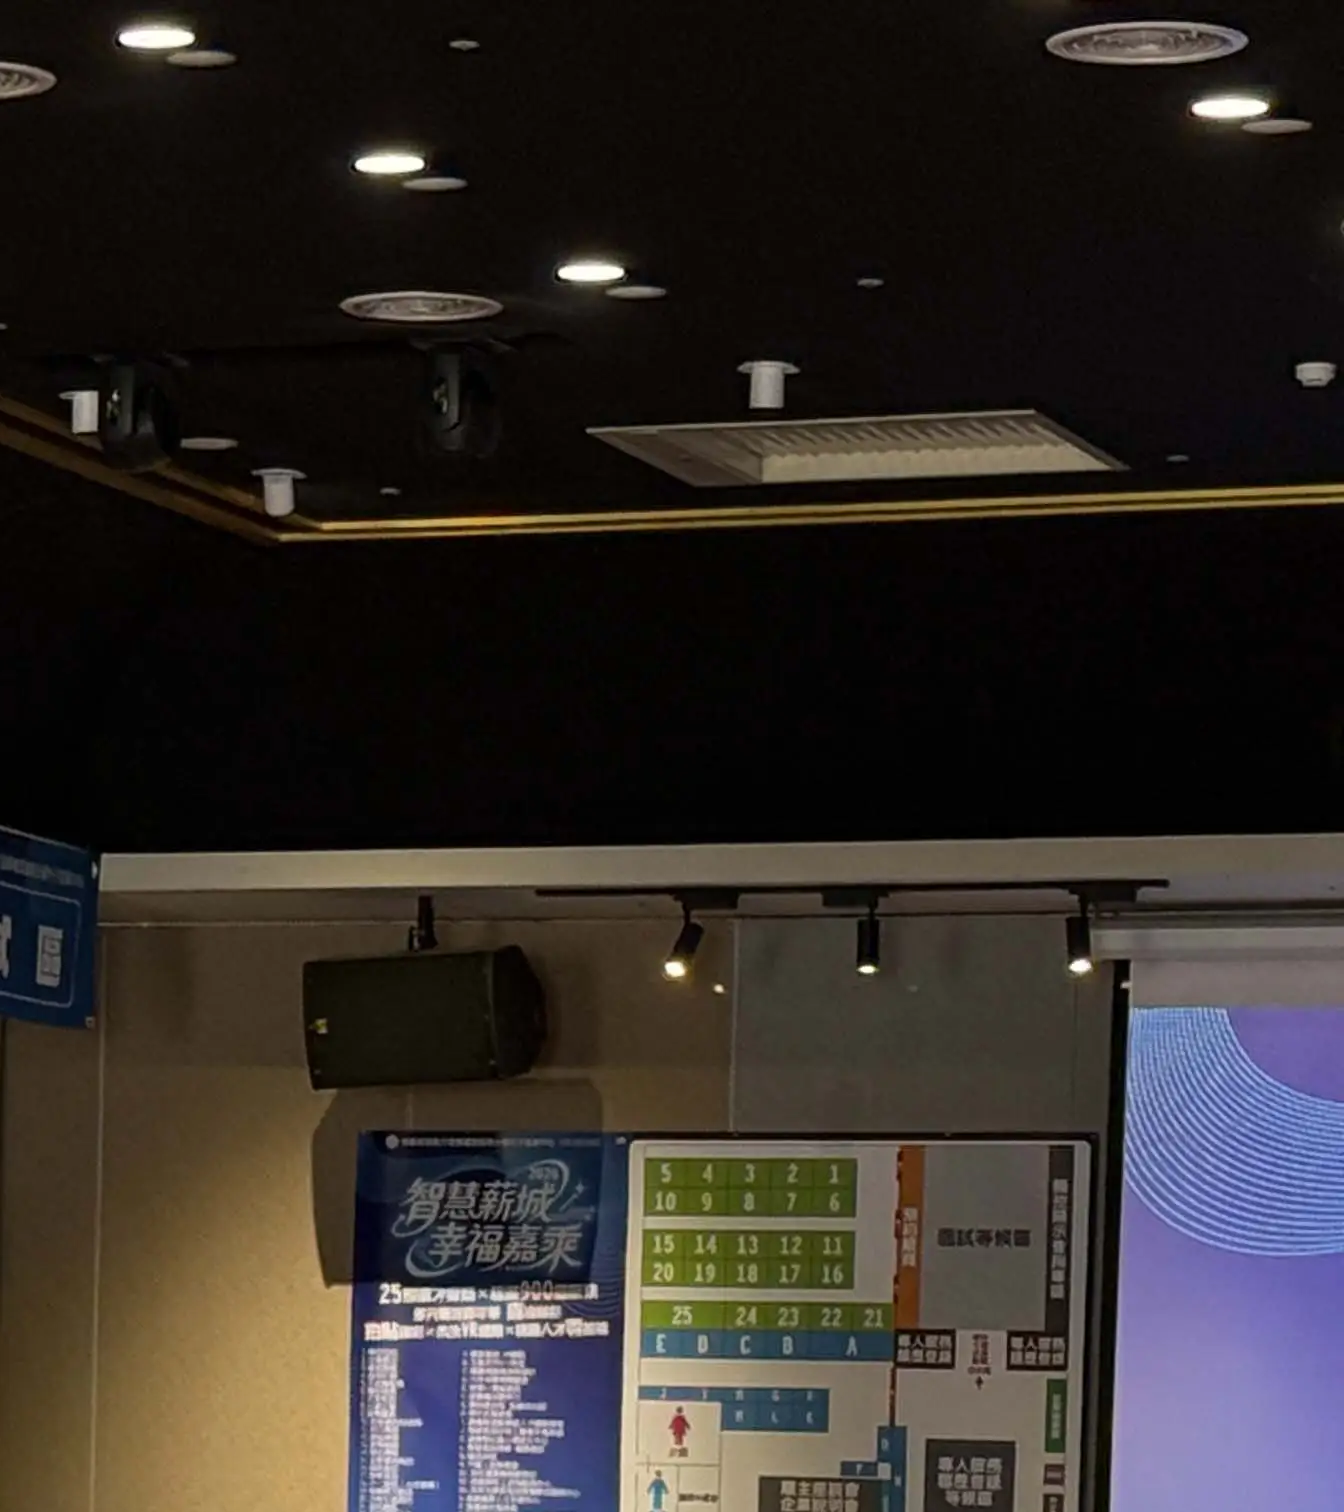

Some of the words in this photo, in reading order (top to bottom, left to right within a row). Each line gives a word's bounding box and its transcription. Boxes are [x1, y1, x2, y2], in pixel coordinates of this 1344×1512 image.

[661, 1165, 671, 1183] 5
[702, 1165, 712, 1183] 4
[745, 1165, 755, 1183] 3
[788, 1165, 798, 1183] 2
[829, 1165, 838, 1183] 1
[401, 1176, 555, 1227] 智慧薪城
[655, 1193, 677, 1211] 10
[702, 1193, 712, 1211] 9
[744, 1193, 755, 1211] 8
[788, 1193, 797, 1211] 7
[829, 1193, 839, 1211] 6
[653, 1236, 675, 1255] 15
[694, 1236, 717, 1255] 14
[737, 1236, 758, 1255] 13
[780, 1236, 801, 1255] 12
[823, 1236, 842, 1255] 11
[653, 1264, 675, 1283] 20
[694, 1264, 716, 1283] 19
[737, 1264, 758, 1283] 18
[780, 1264, 800, 1283] 17
[822, 1264, 843, 1283] 16
[672, 1307, 692, 1327] 25
[736, 1307, 757, 1327] 24
[778, 1307, 800, 1327] 23
[821, 1307, 842, 1327] 22
[863, 1307, 883, 1327] 21
[740, 1335, 751, 1355] C
[783, 1335, 793, 1355] B
[846, 1335, 857, 1355] A
